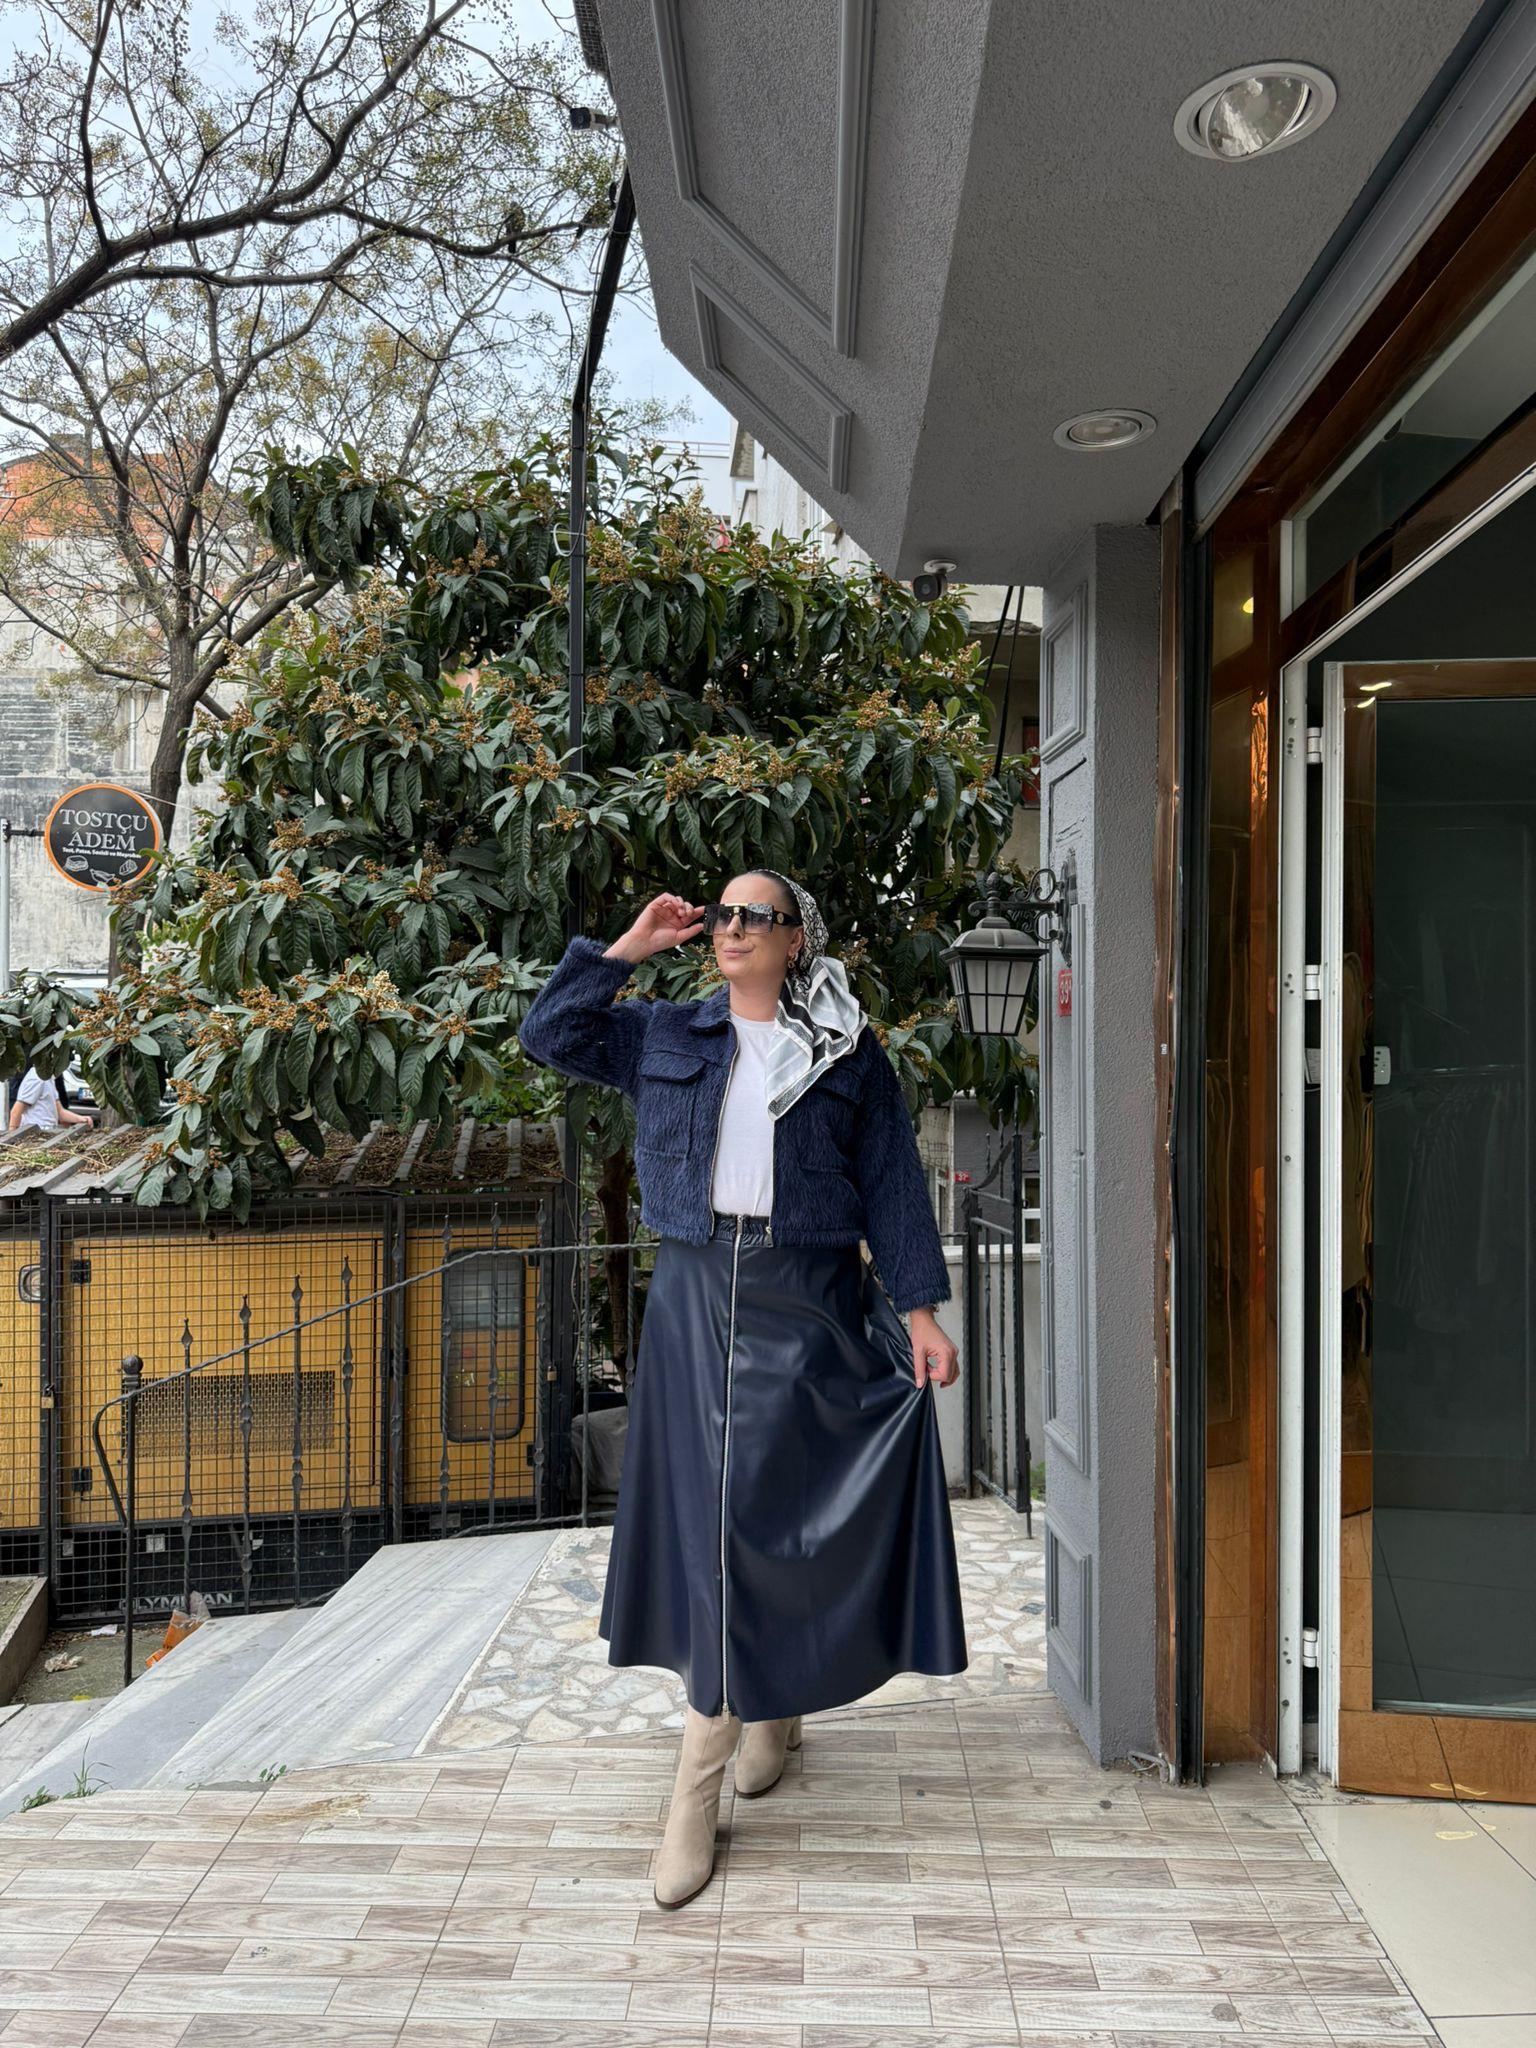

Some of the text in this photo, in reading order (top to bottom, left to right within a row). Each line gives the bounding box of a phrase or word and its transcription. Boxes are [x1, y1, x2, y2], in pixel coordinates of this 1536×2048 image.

[59, 809, 148, 834] TOSTÇU
[67, 832, 136, 852] ADEM
[118, 1592, 233, 1610] OLYMAN
